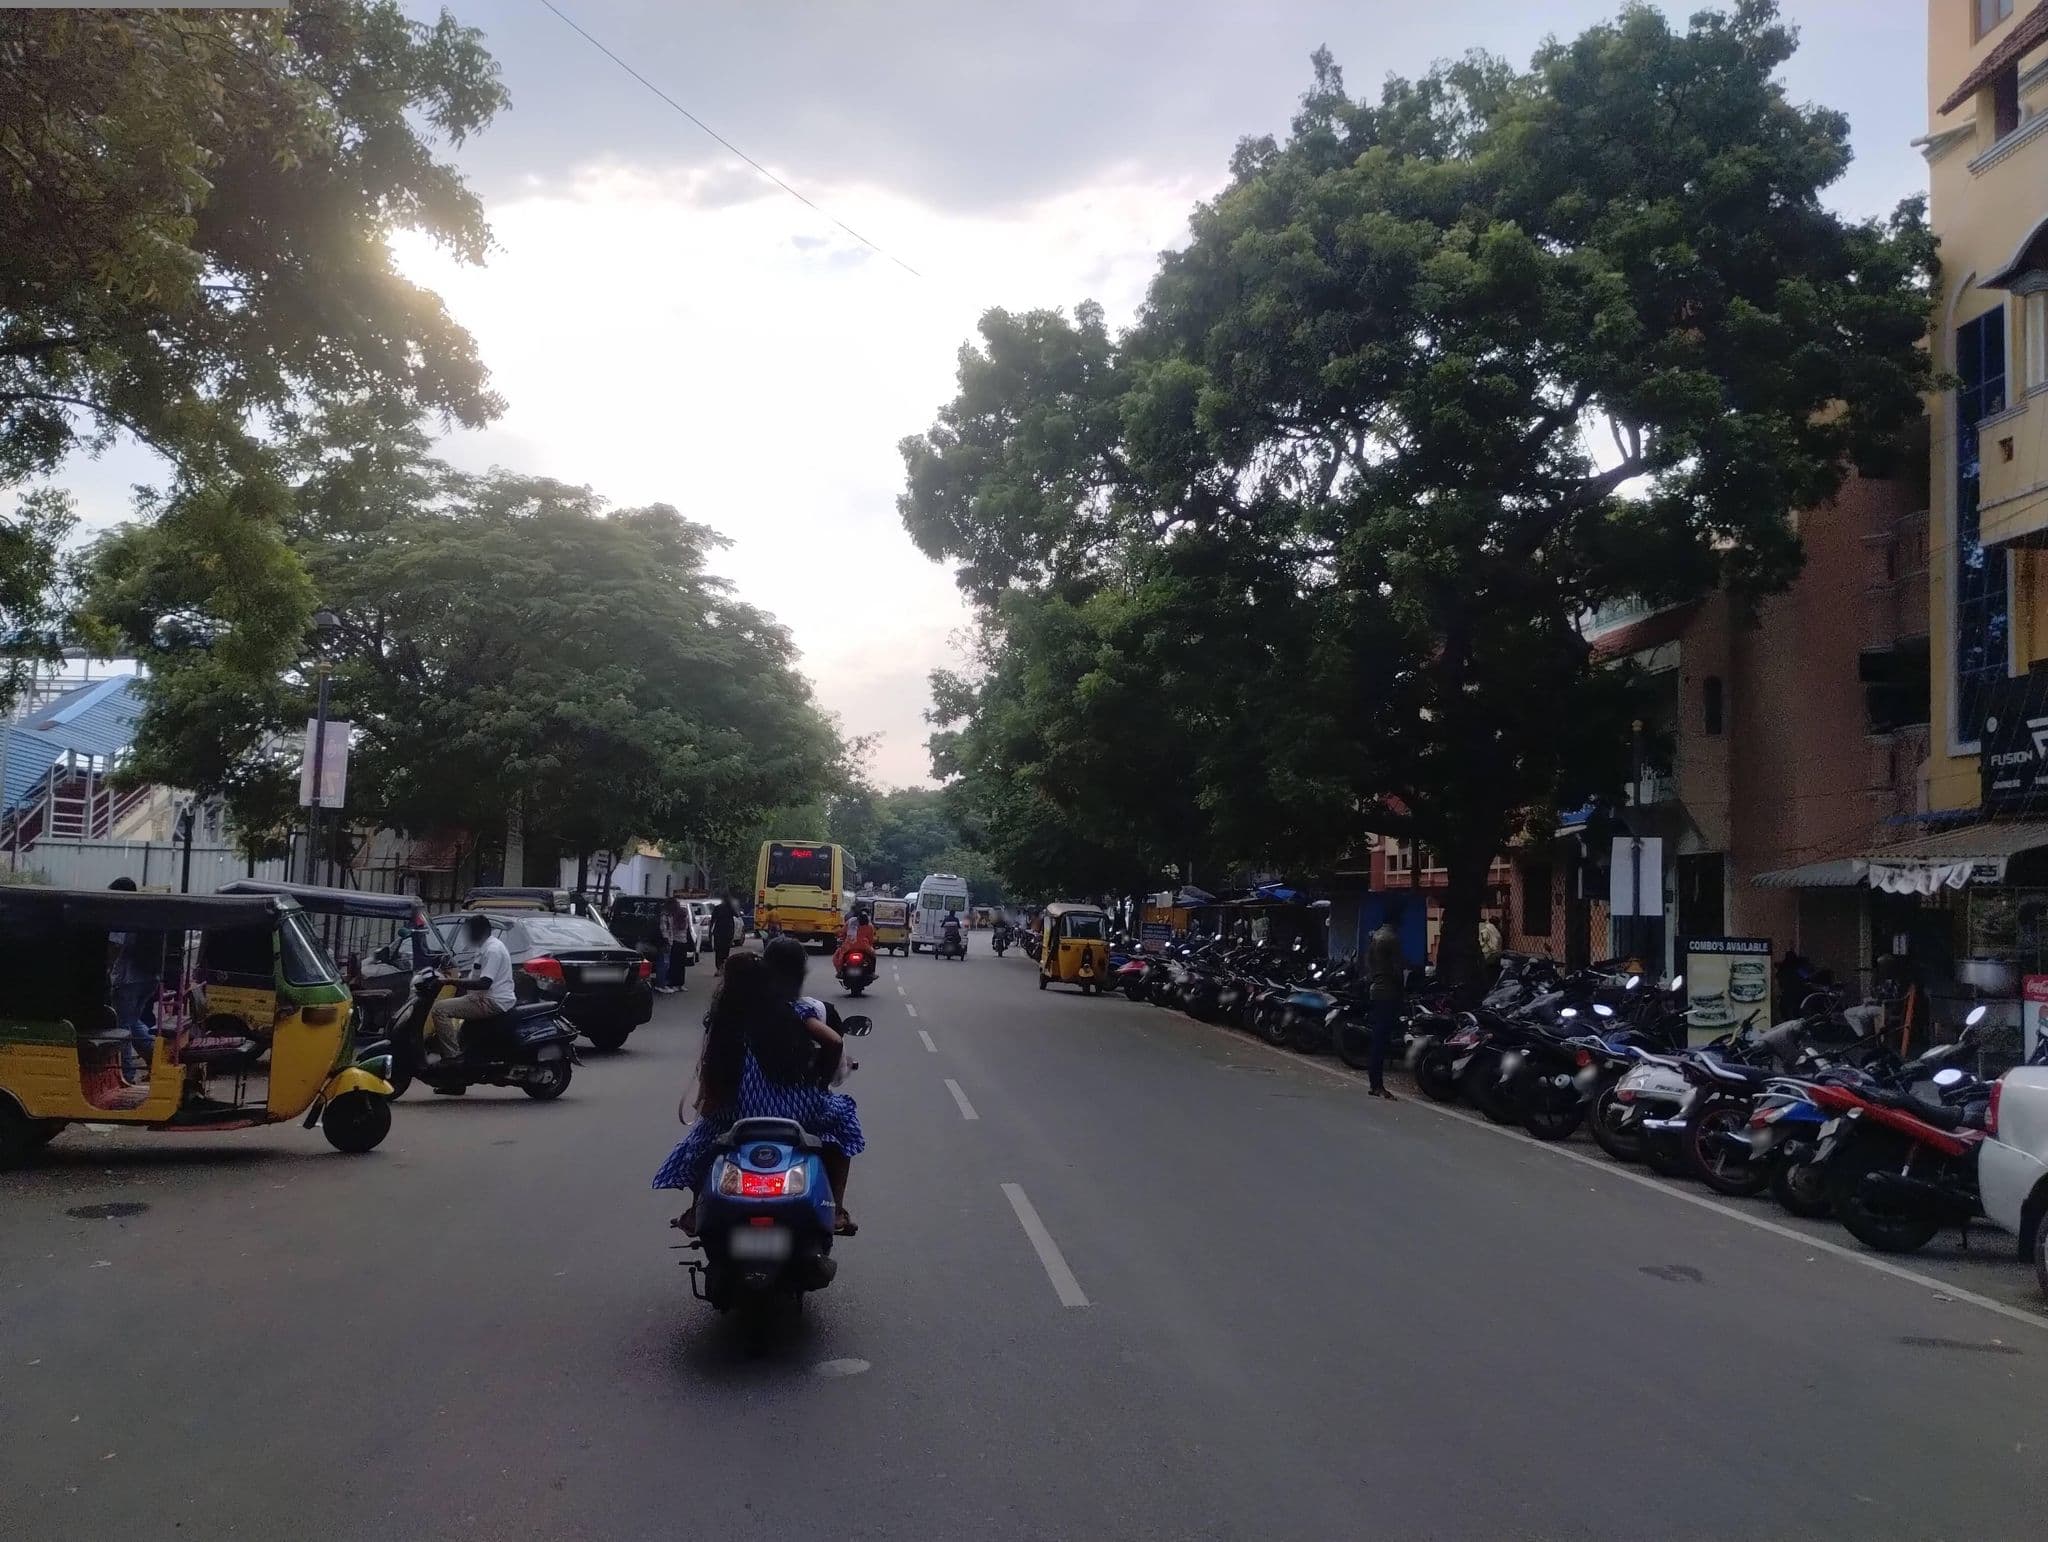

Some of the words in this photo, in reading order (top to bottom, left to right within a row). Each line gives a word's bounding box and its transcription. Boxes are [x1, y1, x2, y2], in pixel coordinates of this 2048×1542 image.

[1990, 750, 2033, 766] FUSION
[1689, 940, 1725, 952] COMBO'S
[1726, 941, 1769, 953] AVAILABLE
